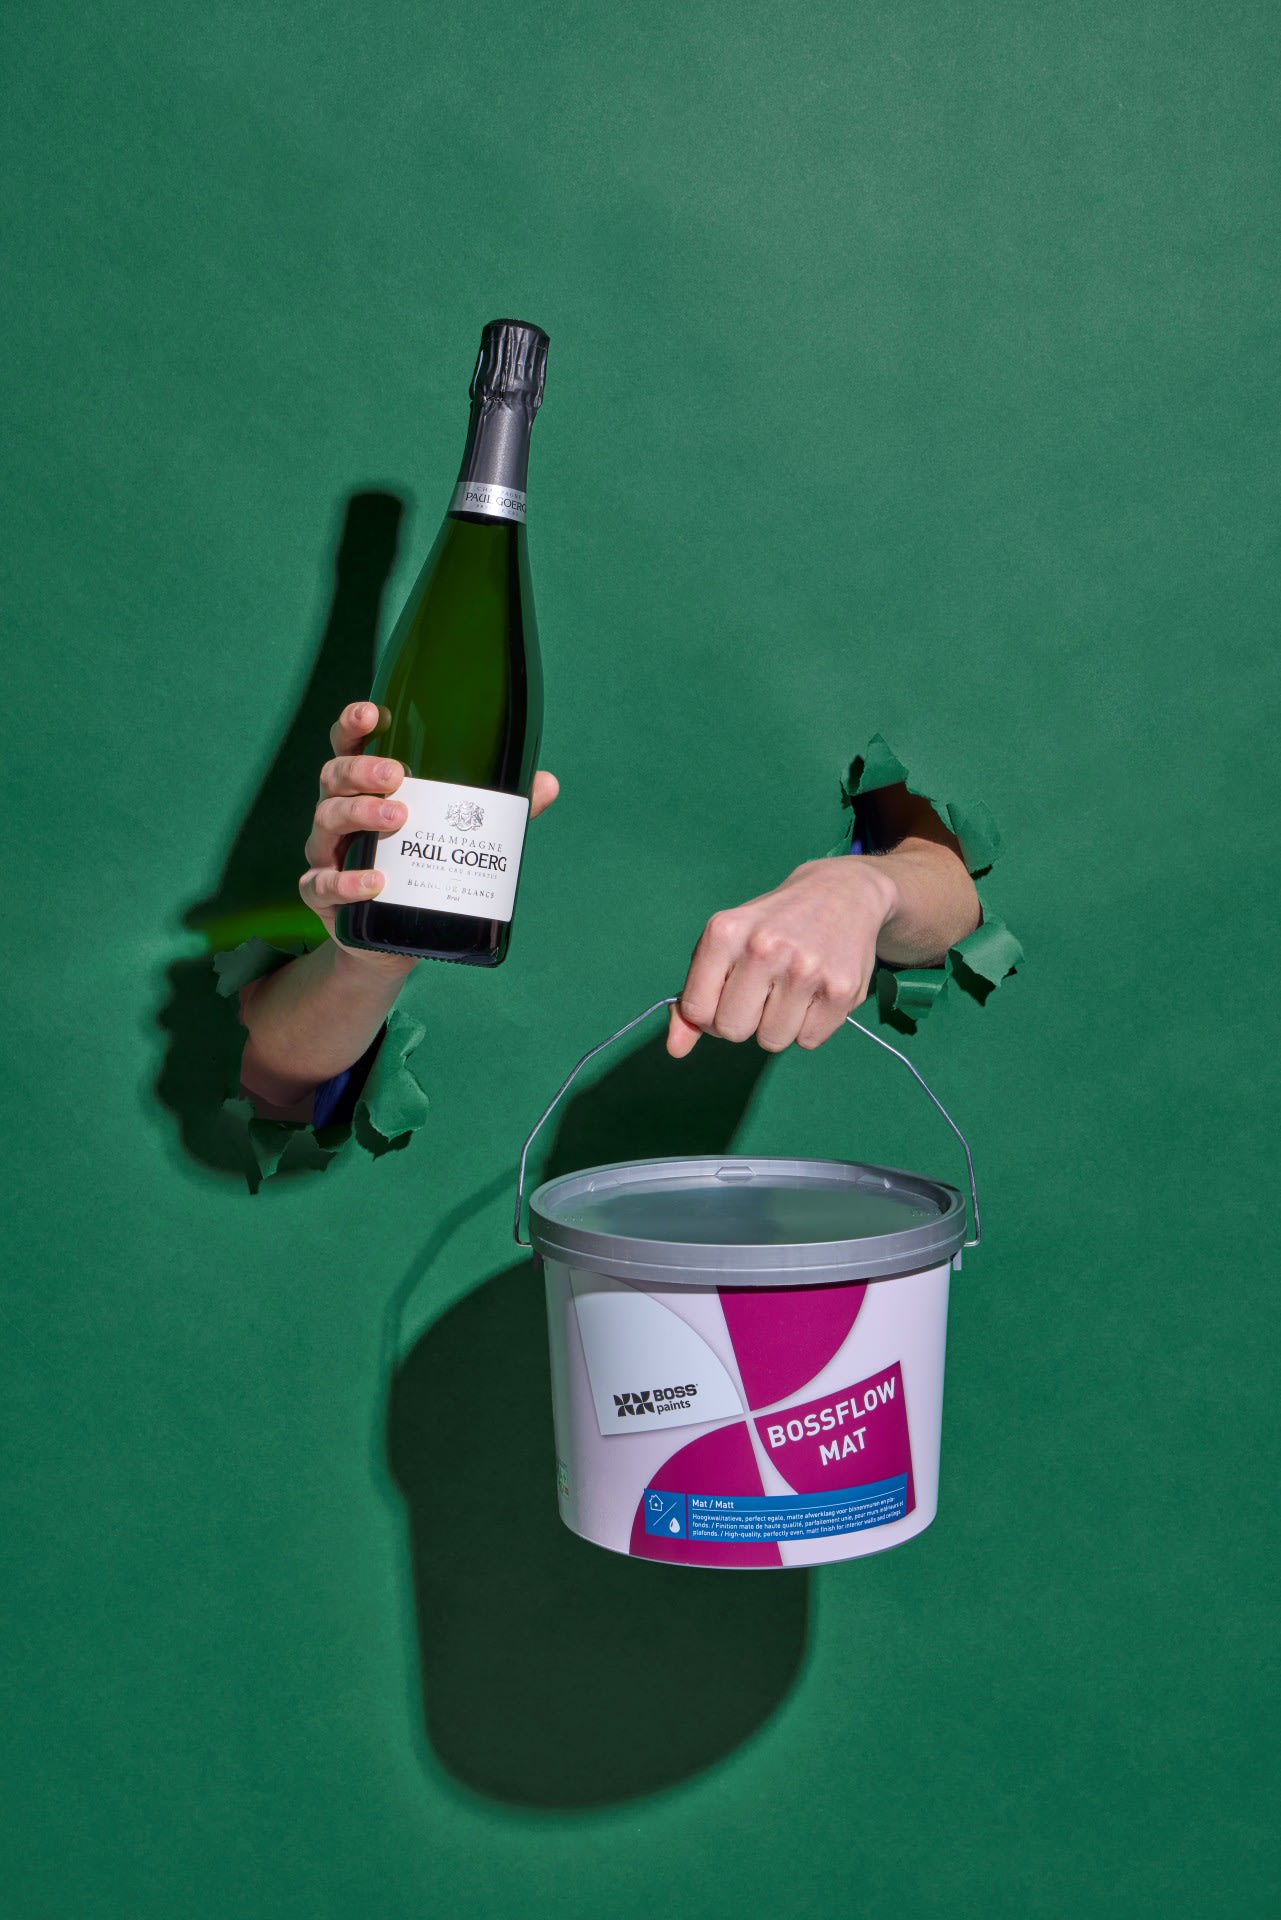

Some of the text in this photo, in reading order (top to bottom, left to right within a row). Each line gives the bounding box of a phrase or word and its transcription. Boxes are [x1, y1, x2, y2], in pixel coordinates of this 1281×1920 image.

[465, 492, 493, 505] PAUL
[495, 496, 526, 513] GOERG
[415, 831, 503, 852] CHAMPAGNE
[400, 840, 507, 872] PAUL GOERG
[461, 887, 495, 899] BLANCS
[652, 1384, 697, 1402] BOSS
[656, 1400, 691, 1415] paints
[767, 1376, 896, 1449] BOSSFLOW
[818, 1426, 867, 1467] MAT
[692, 1499, 708, 1508] Mat
[715, 1500, 734, 1509] Matt
[715, 1522, 738, 1530] Finition
[804, 1517, 841, 1528] parfaitement
[744, 1515, 766, 1523] perfect
[804, 1510, 836, 1519] afwerklaag
[763, 1529, 789, 1538] perfectly
[820, 1525, 836, 1533] finish
[836, 1523, 845, 1531] for
